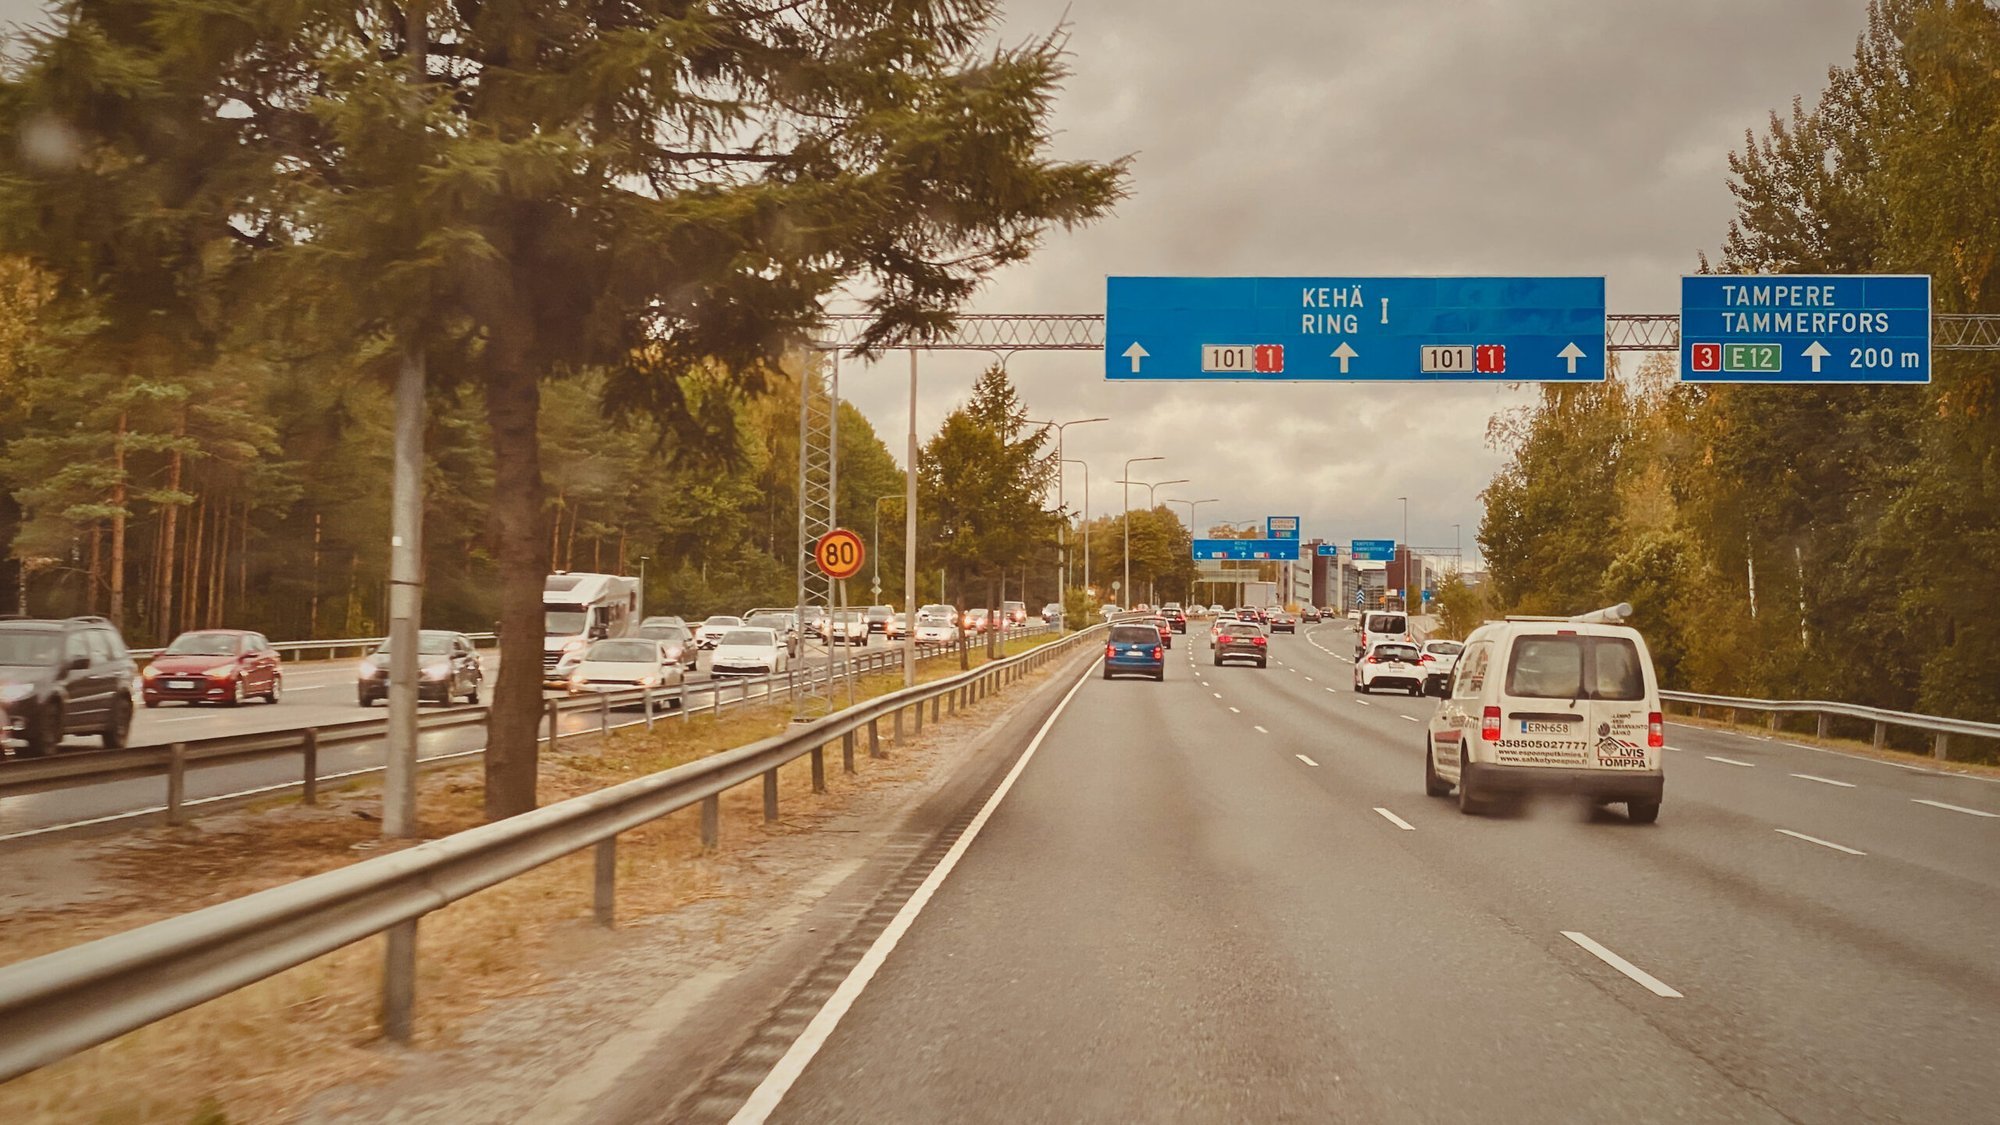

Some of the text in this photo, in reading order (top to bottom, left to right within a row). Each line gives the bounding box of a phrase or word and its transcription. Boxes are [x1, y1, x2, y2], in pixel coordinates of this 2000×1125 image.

[1302, 284, 1364, 308] KEHÄ
[1722, 285, 1835, 306] TAMPERE
[1381, 297, 1389, 324] I
[1302, 314, 1358, 334] RING
[1722, 312, 1889, 333] TAMMERFORS
[1213, 348, 1273, 369] 101 1
[1431, 348, 1495, 369] 101 1
[1700, 347, 1920, 368] 3 E12 200 m
[826, 542, 854, 567] 80
[1528, 723, 1569, 733] ERN-658
[1493, 739, 1587, 750] +358505027777
[1620, 748, 1644, 758] LVIS
[1598, 758, 1646, 768] TOMPPA
